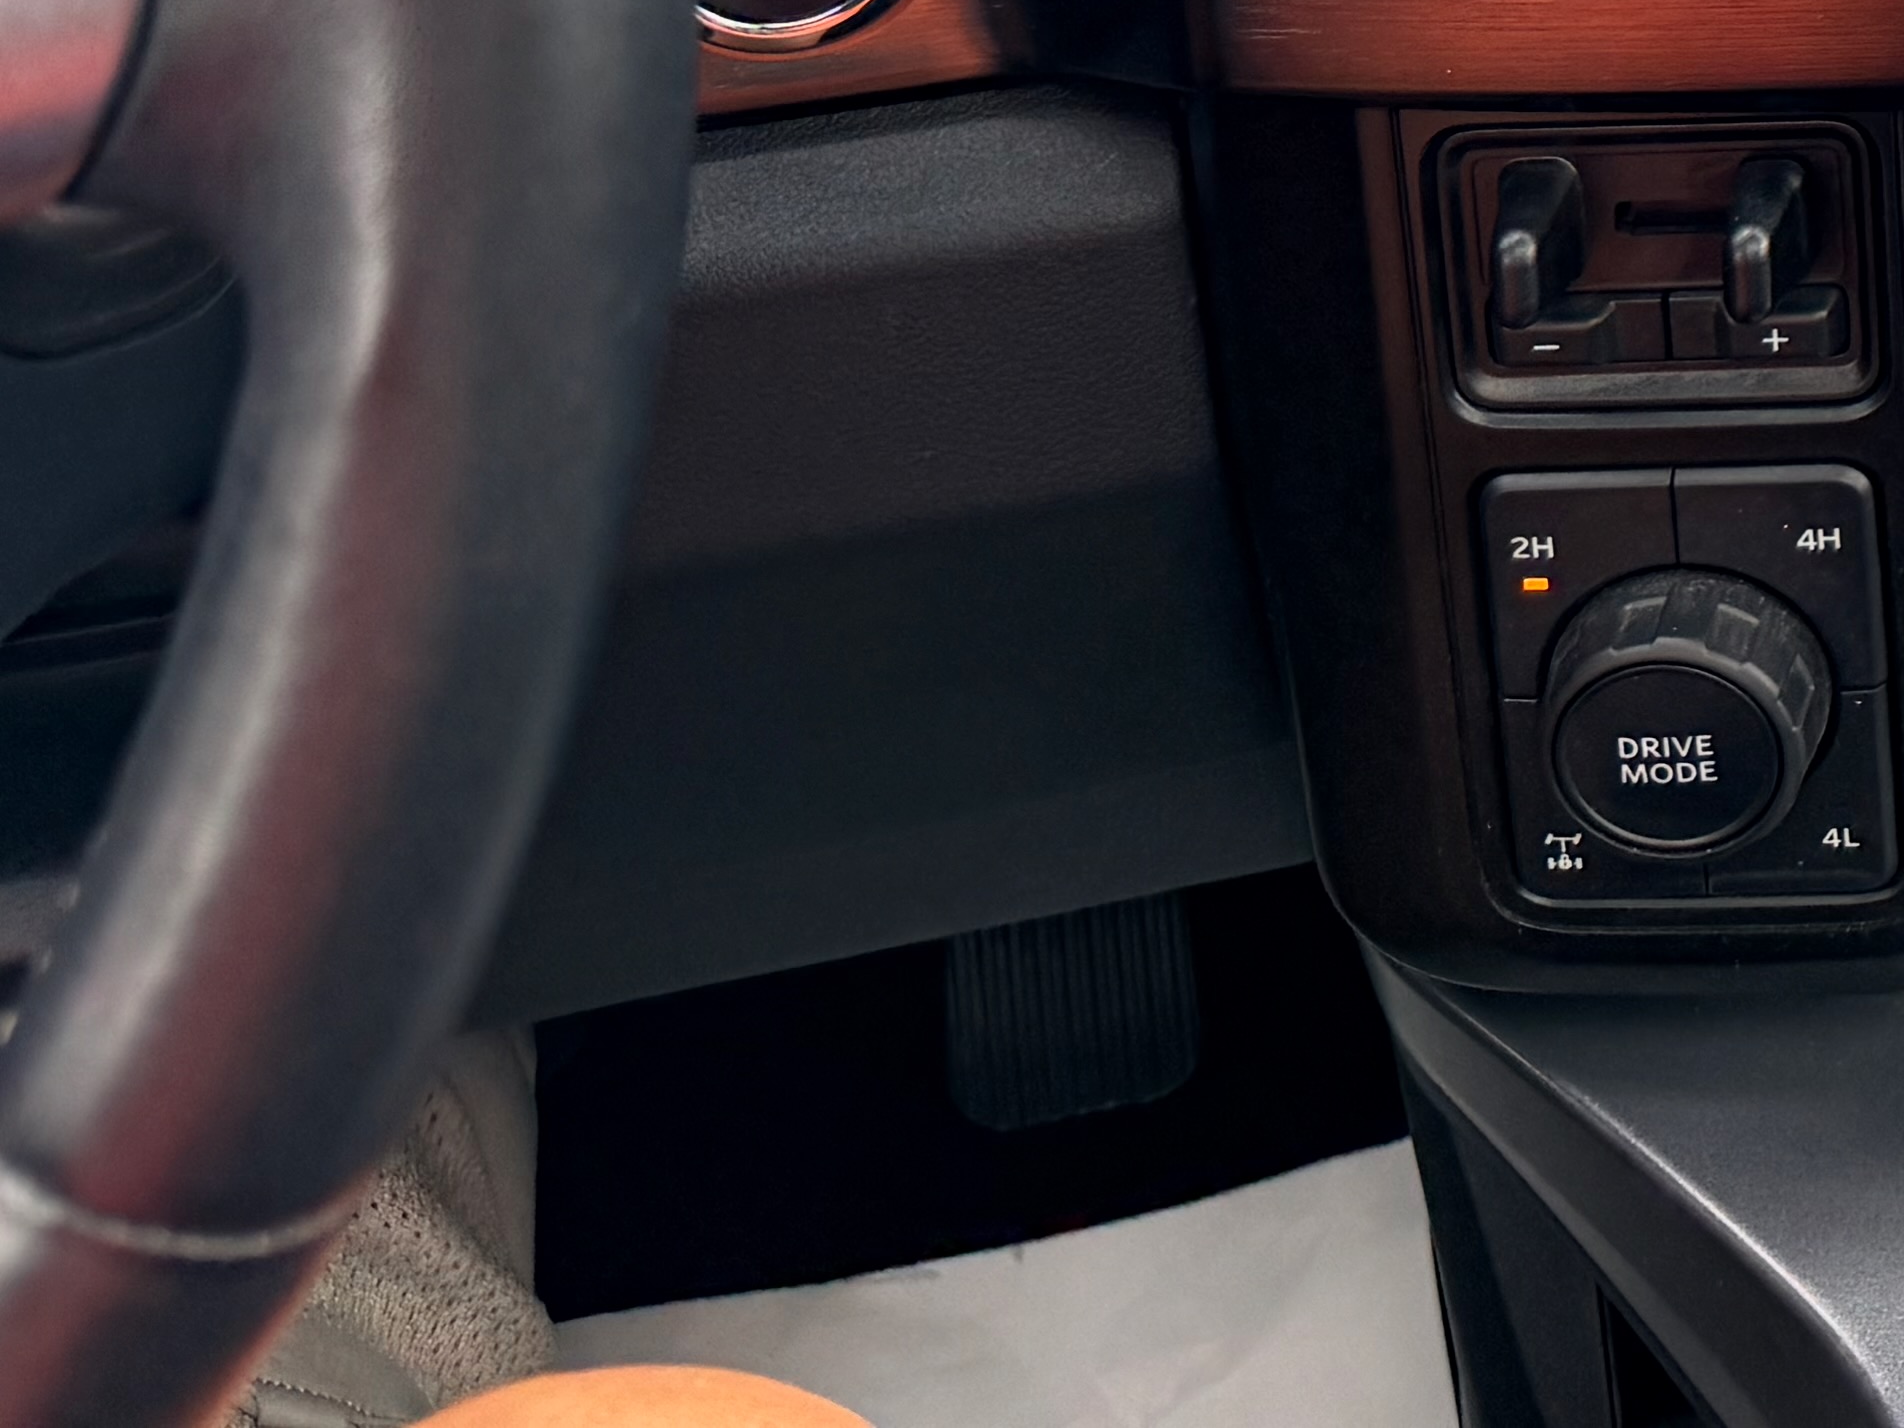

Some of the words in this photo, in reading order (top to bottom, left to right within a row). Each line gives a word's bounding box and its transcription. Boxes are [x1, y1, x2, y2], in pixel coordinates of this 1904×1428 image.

[1509, 536, 1555, 560] 2H
[1795, 527, 1842, 552] 4H
[1617, 734, 1715, 760] DRIVE
[1620, 760, 1719, 785] MODE
[1821, 827, 1861, 849] 4L
